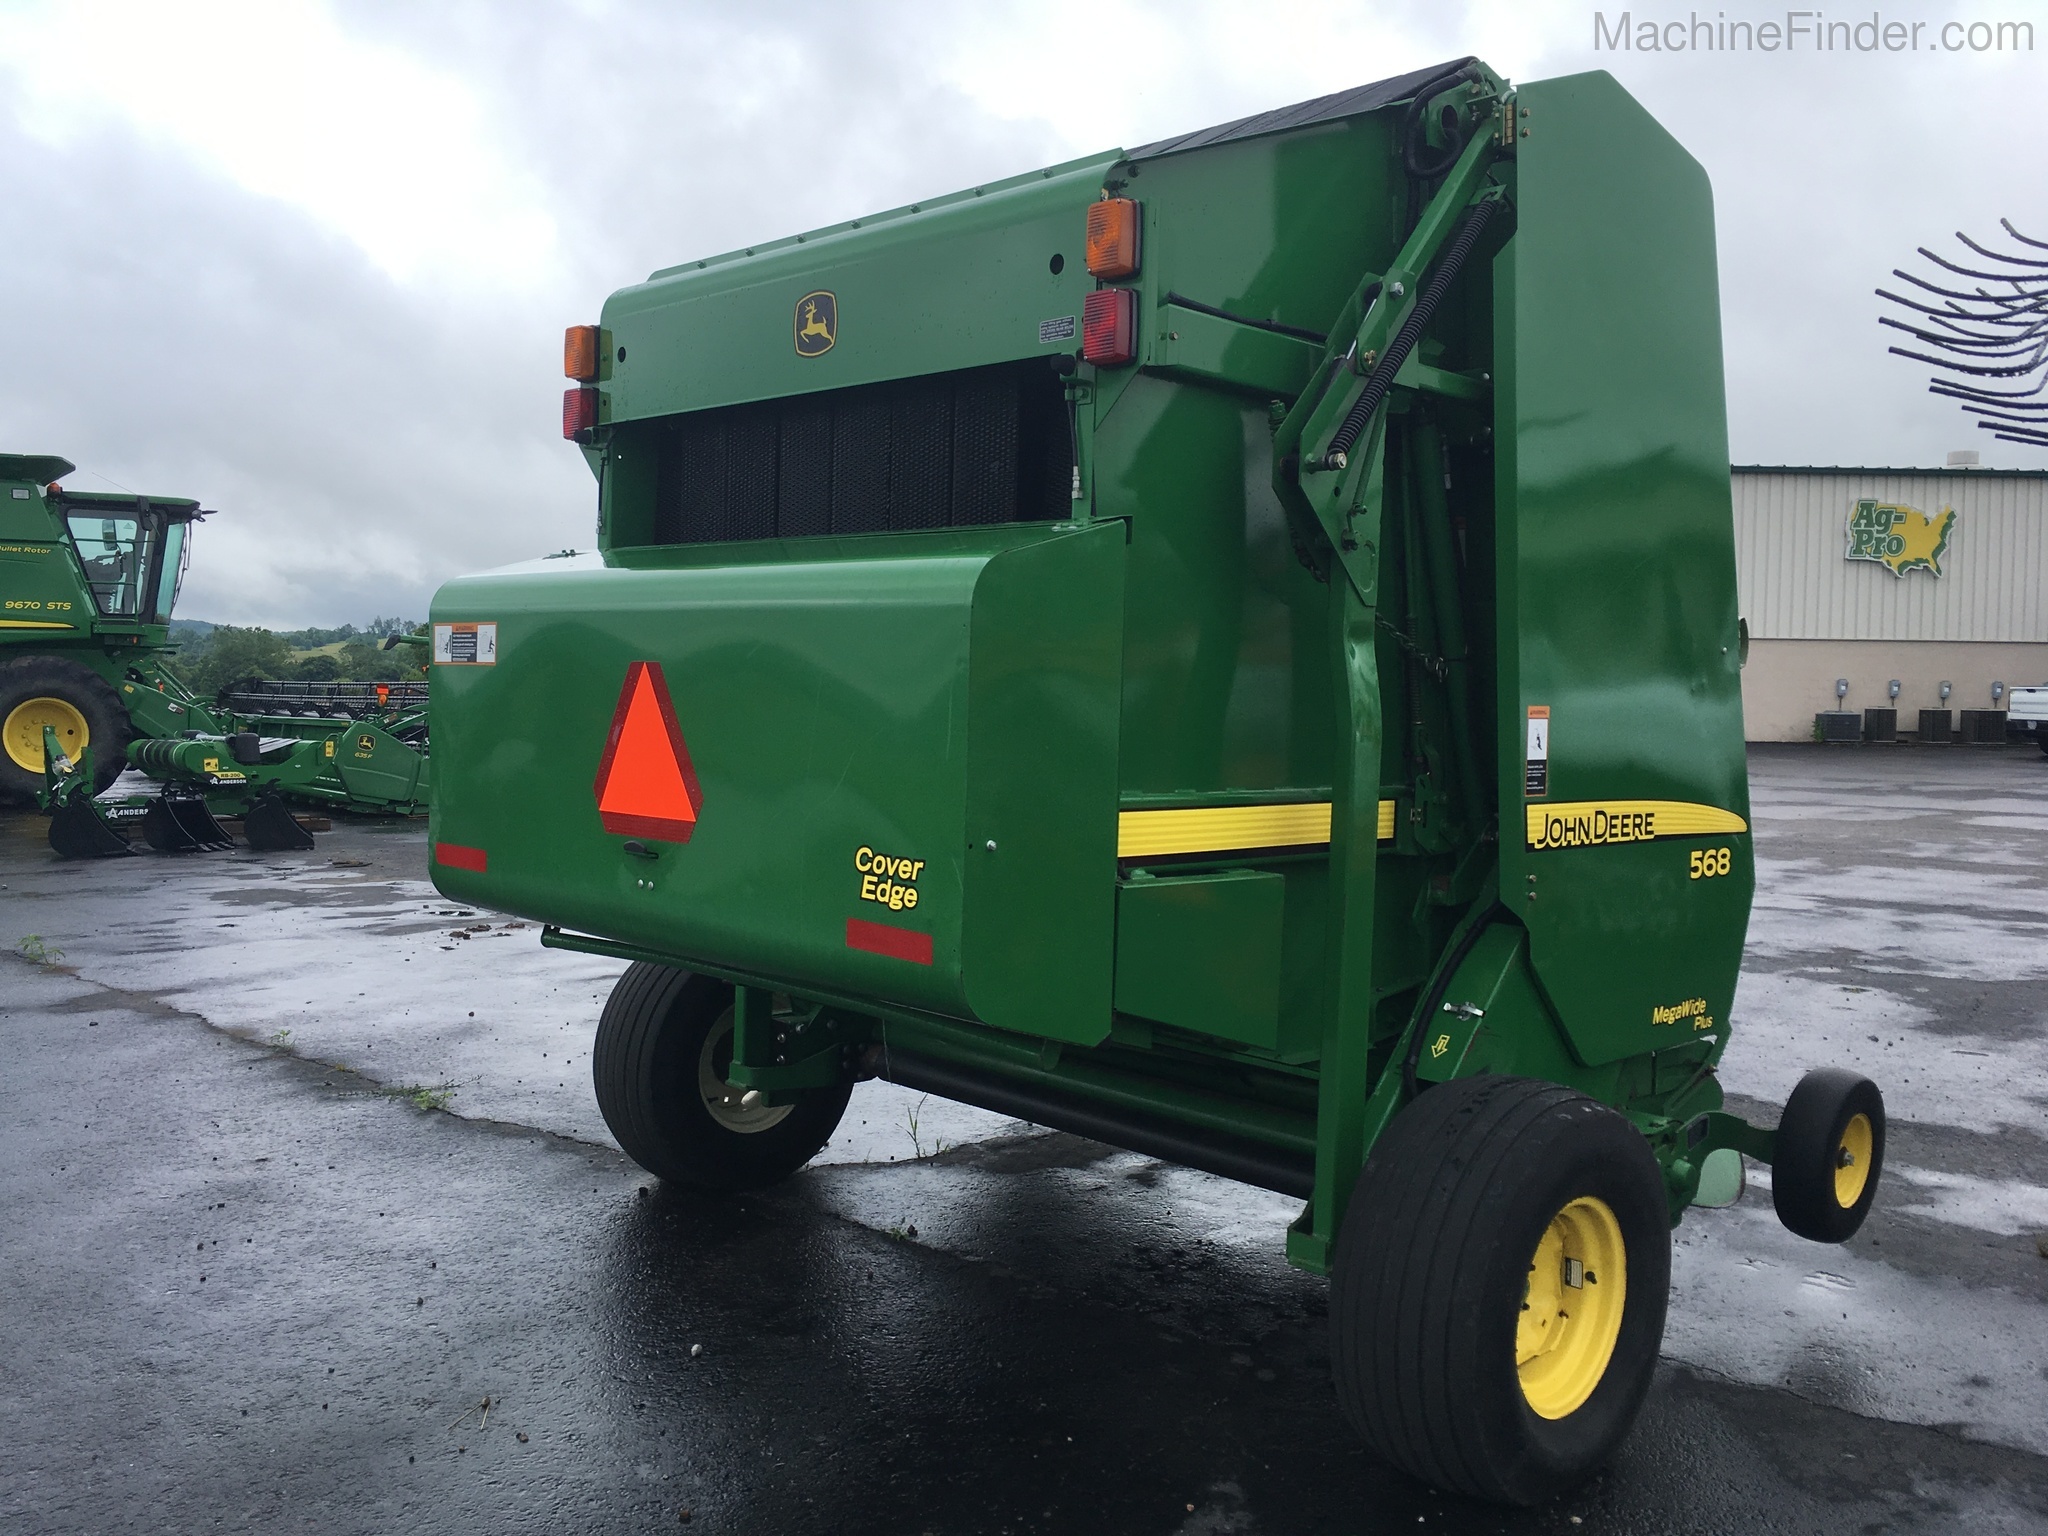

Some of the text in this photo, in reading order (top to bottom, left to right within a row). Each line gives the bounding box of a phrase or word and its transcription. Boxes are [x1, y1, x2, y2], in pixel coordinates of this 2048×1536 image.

[1851, 500, 1907, 534] Ag-
[24, 546, 51, 554] Rotor
[1850, 528, 1906, 557] Pro
[5, 601, 72, 610] 9670 STS
[1536, 811, 1655, 847] JOHN DEERE
[855, 846, 925, 881] Cover
[1689, 847, 1731, 879] 568
[860, 874, 918, 911] Edge
[1652, 997, 1706, 1025] MegaWide
[1694, 1015, 1713, 1031] Plus
